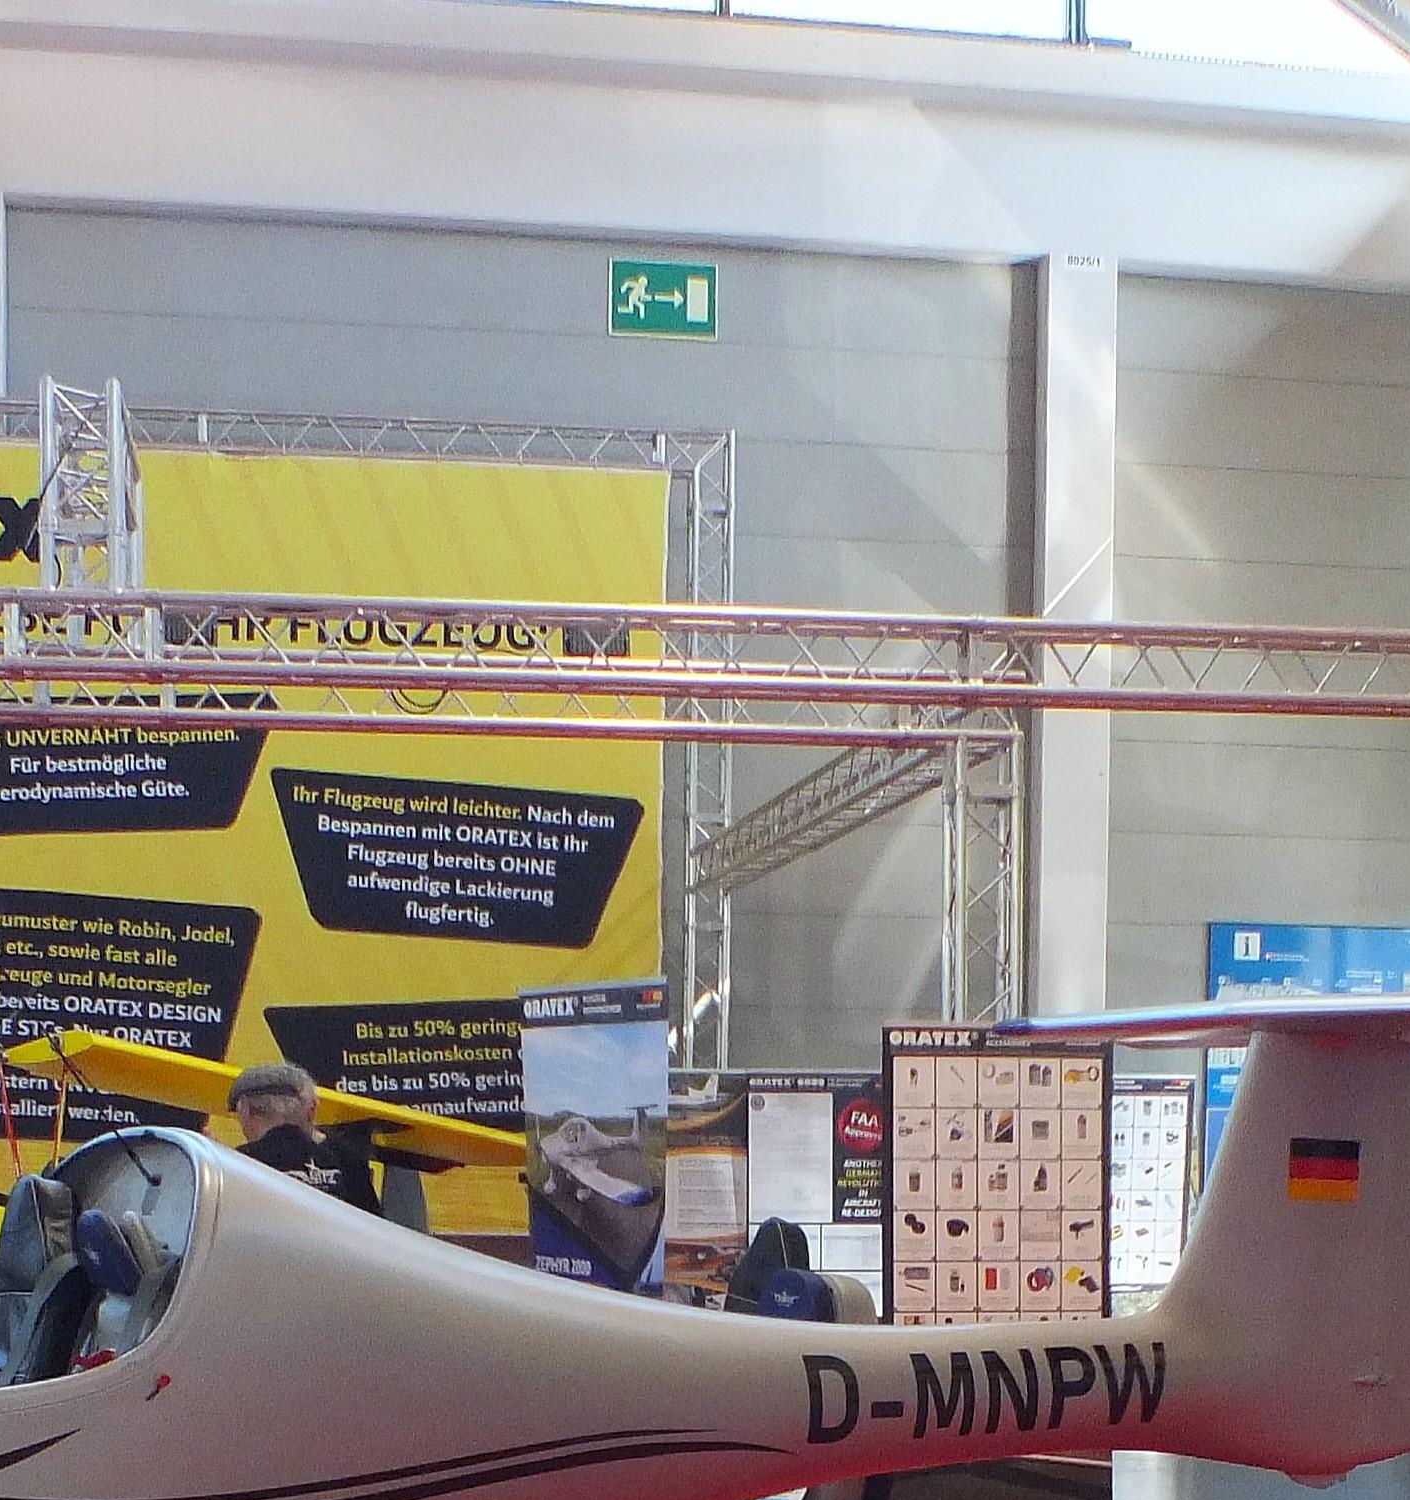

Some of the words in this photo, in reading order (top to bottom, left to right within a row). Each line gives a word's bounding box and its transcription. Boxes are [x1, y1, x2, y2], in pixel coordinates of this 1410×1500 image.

[137, 727, 240, 748] bespannen.
[10, 756, 41, 775] Für
[46, 753, 167, 776] bestmögliche
[141, 779, 189, 798] Güte.
[293, 785, 318, 805] Ihr
[324, 788, 405, 815] Flugzeug
[410, 796, 449, 815] wird
[453, 798, 522, 821] leichter.
[527, 805, 573, 827] Nach
[578, 809, 616, 829] dem
[318, 814, 417, 842] Bespannen
[422, 823, 452, 841] mit
[456, 827, 532, 849] ORATEX
[538, 832, 559, 851] ist
[564, 833, 589, 853] Ihr
[347, 844, 429, 870] Flugzeug
[434, 850, 496, 872] bereits
[500, 856, 557, 877] OHNE
[347, 871, 451, 896] aufwendige
[456, 879, 555, 907] Lackierung
[405, 901, 495, 928] flugfertig.
[83, 917, 113, 935] wie
[118, 920, 177, 941] Robin,
[181, 925, 236, 947] Jodel,
[48, 942, 101, 961] sowie
[106, 945, 140, 965] fast
[145, 947, 178, 967] alle
[58, 968, 94, 986] und
[98, 971, 213, 998] Motorsegler
[64, 995, 143, 1018] ORATEX
[149, 1002, 222, 1024] DESIGN
[523, 996, 575, 1020] ORATEX
[114, 1026, 192, 1048] ORATEX
[356, 1022, 383, 1039] Bis
[388, 1025, 409, 1040] zu
[414, 1020, 456, 1038] 50%
[888, 1030, 972, 1047] ORATEX
[343, 1044, 513, 1067] Installationskosten
[336, 1075, 367, 1093] des
[371, 1074, 399, 1091] bis
[402, 1076, 423, 1091] zu
[428, 1071, 471, 1090] 50%
[475, 1069, 524, 1092] gerin
[850, 1110, 879, 1127] FAA
[801, 1341, 1166, 1445] D-MNPW
